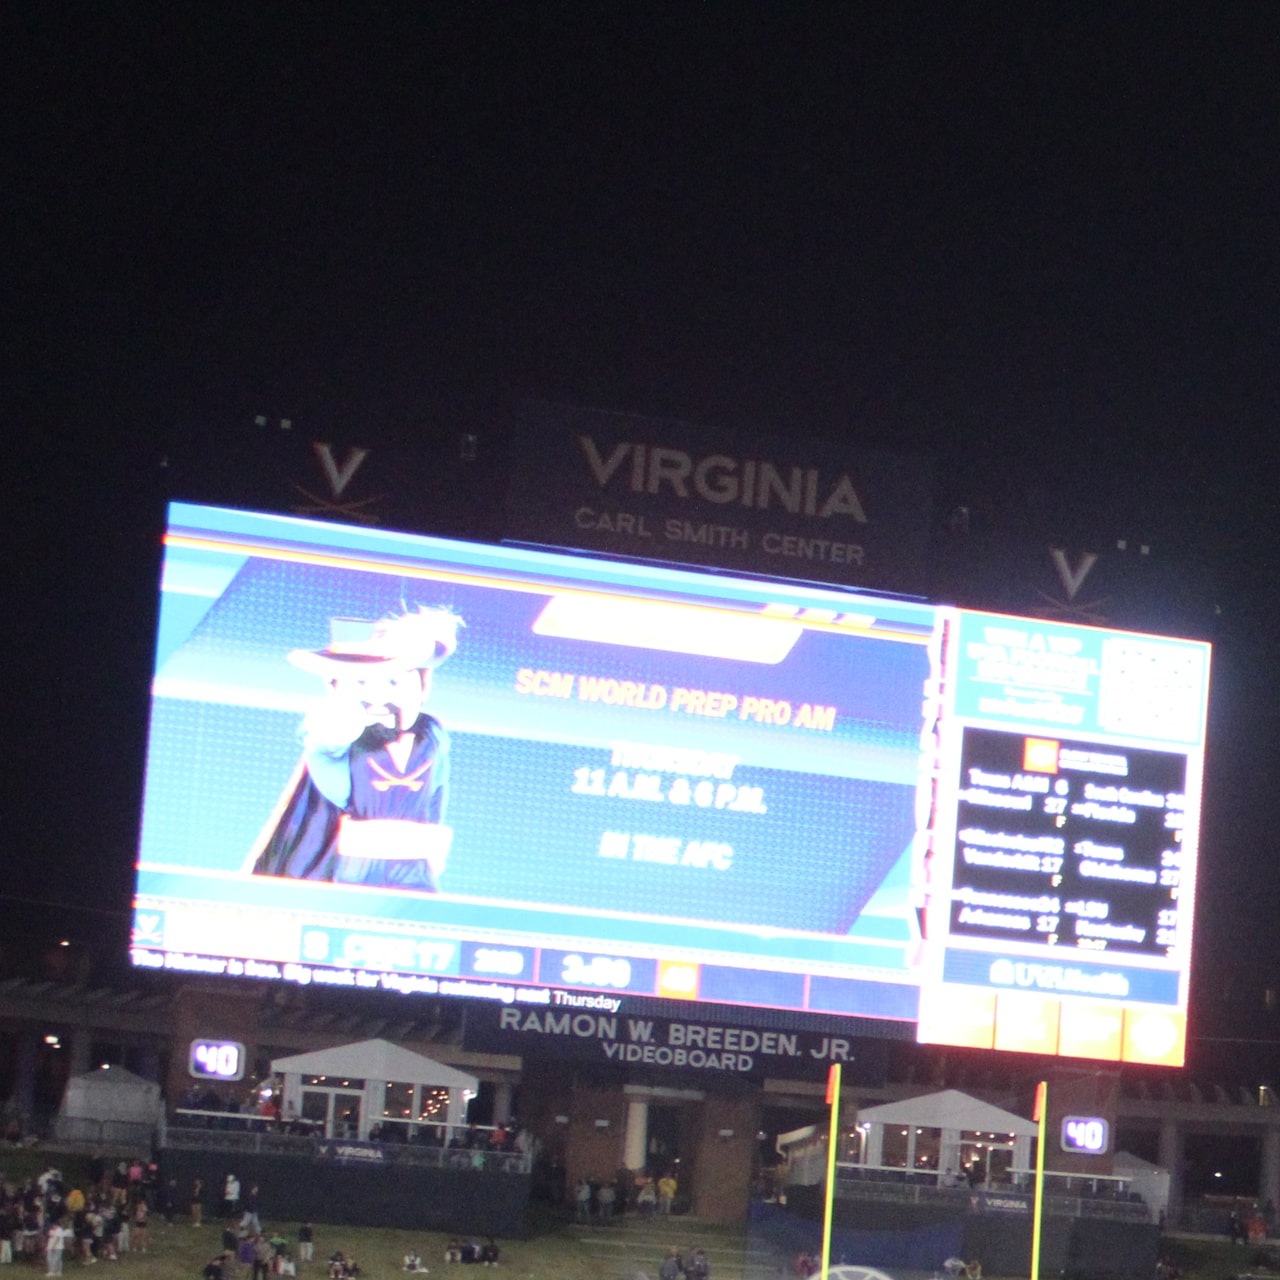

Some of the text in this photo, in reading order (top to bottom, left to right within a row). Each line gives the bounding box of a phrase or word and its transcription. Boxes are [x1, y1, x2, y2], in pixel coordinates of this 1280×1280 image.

[578, 436, 867, 524] VIRGINIA
[575, 508, 865, 567] CARL SMITH CENTER
[515, 668, 836, 731] SCM WORLD PREP PRO AM
[552, 990, 622, 1012] Thursday
[500, 1007, 617, 1040] RAMON
[628, 1018, 654, 1043] W.
[810, 1039, 855, 1062] JR.
[195, 1044, 239, 1076] 40
[603, 1041, 753, 1072] VIDEOBOARD
[1065, 1120, 1104, 1151] 40
